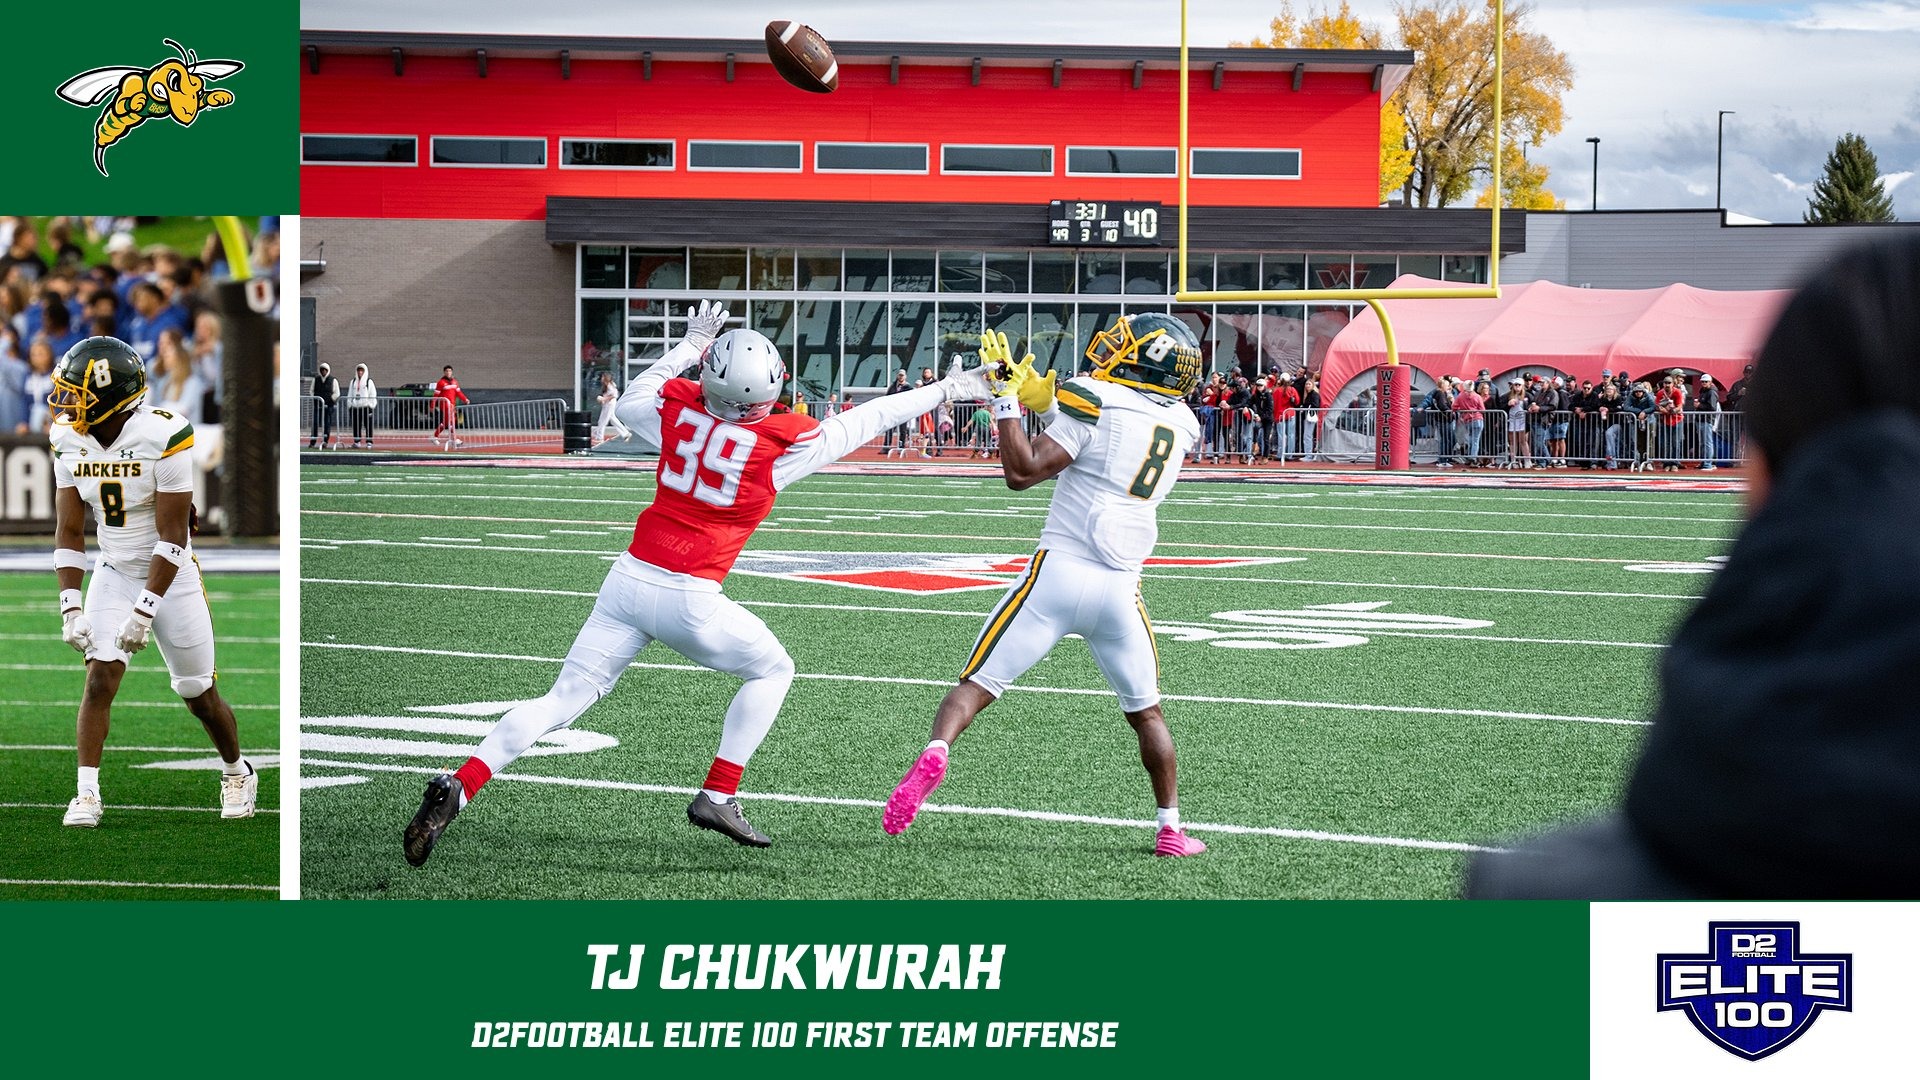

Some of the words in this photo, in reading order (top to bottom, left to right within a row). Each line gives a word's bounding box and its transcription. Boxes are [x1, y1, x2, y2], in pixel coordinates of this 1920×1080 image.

[1074, 202, 1107, 221] 3:31
[1123, 207, 1158, 239] 40
[1052, 228, 1070, 241] 49
[1080, 228, 1091, 242] 3
[1105, 228, 1119, 242] 10
[1144, 333, 1177, 363] 8
[93, 358, 112, 389] 8
[1380, 370, 1394, 466] WESTERN
[73, 461, 142, 478] JACKETS
[660, 406, 758, 507] 39
[1128, 423, 1176, 500] 8
[98, 480, 126, 528] 8
